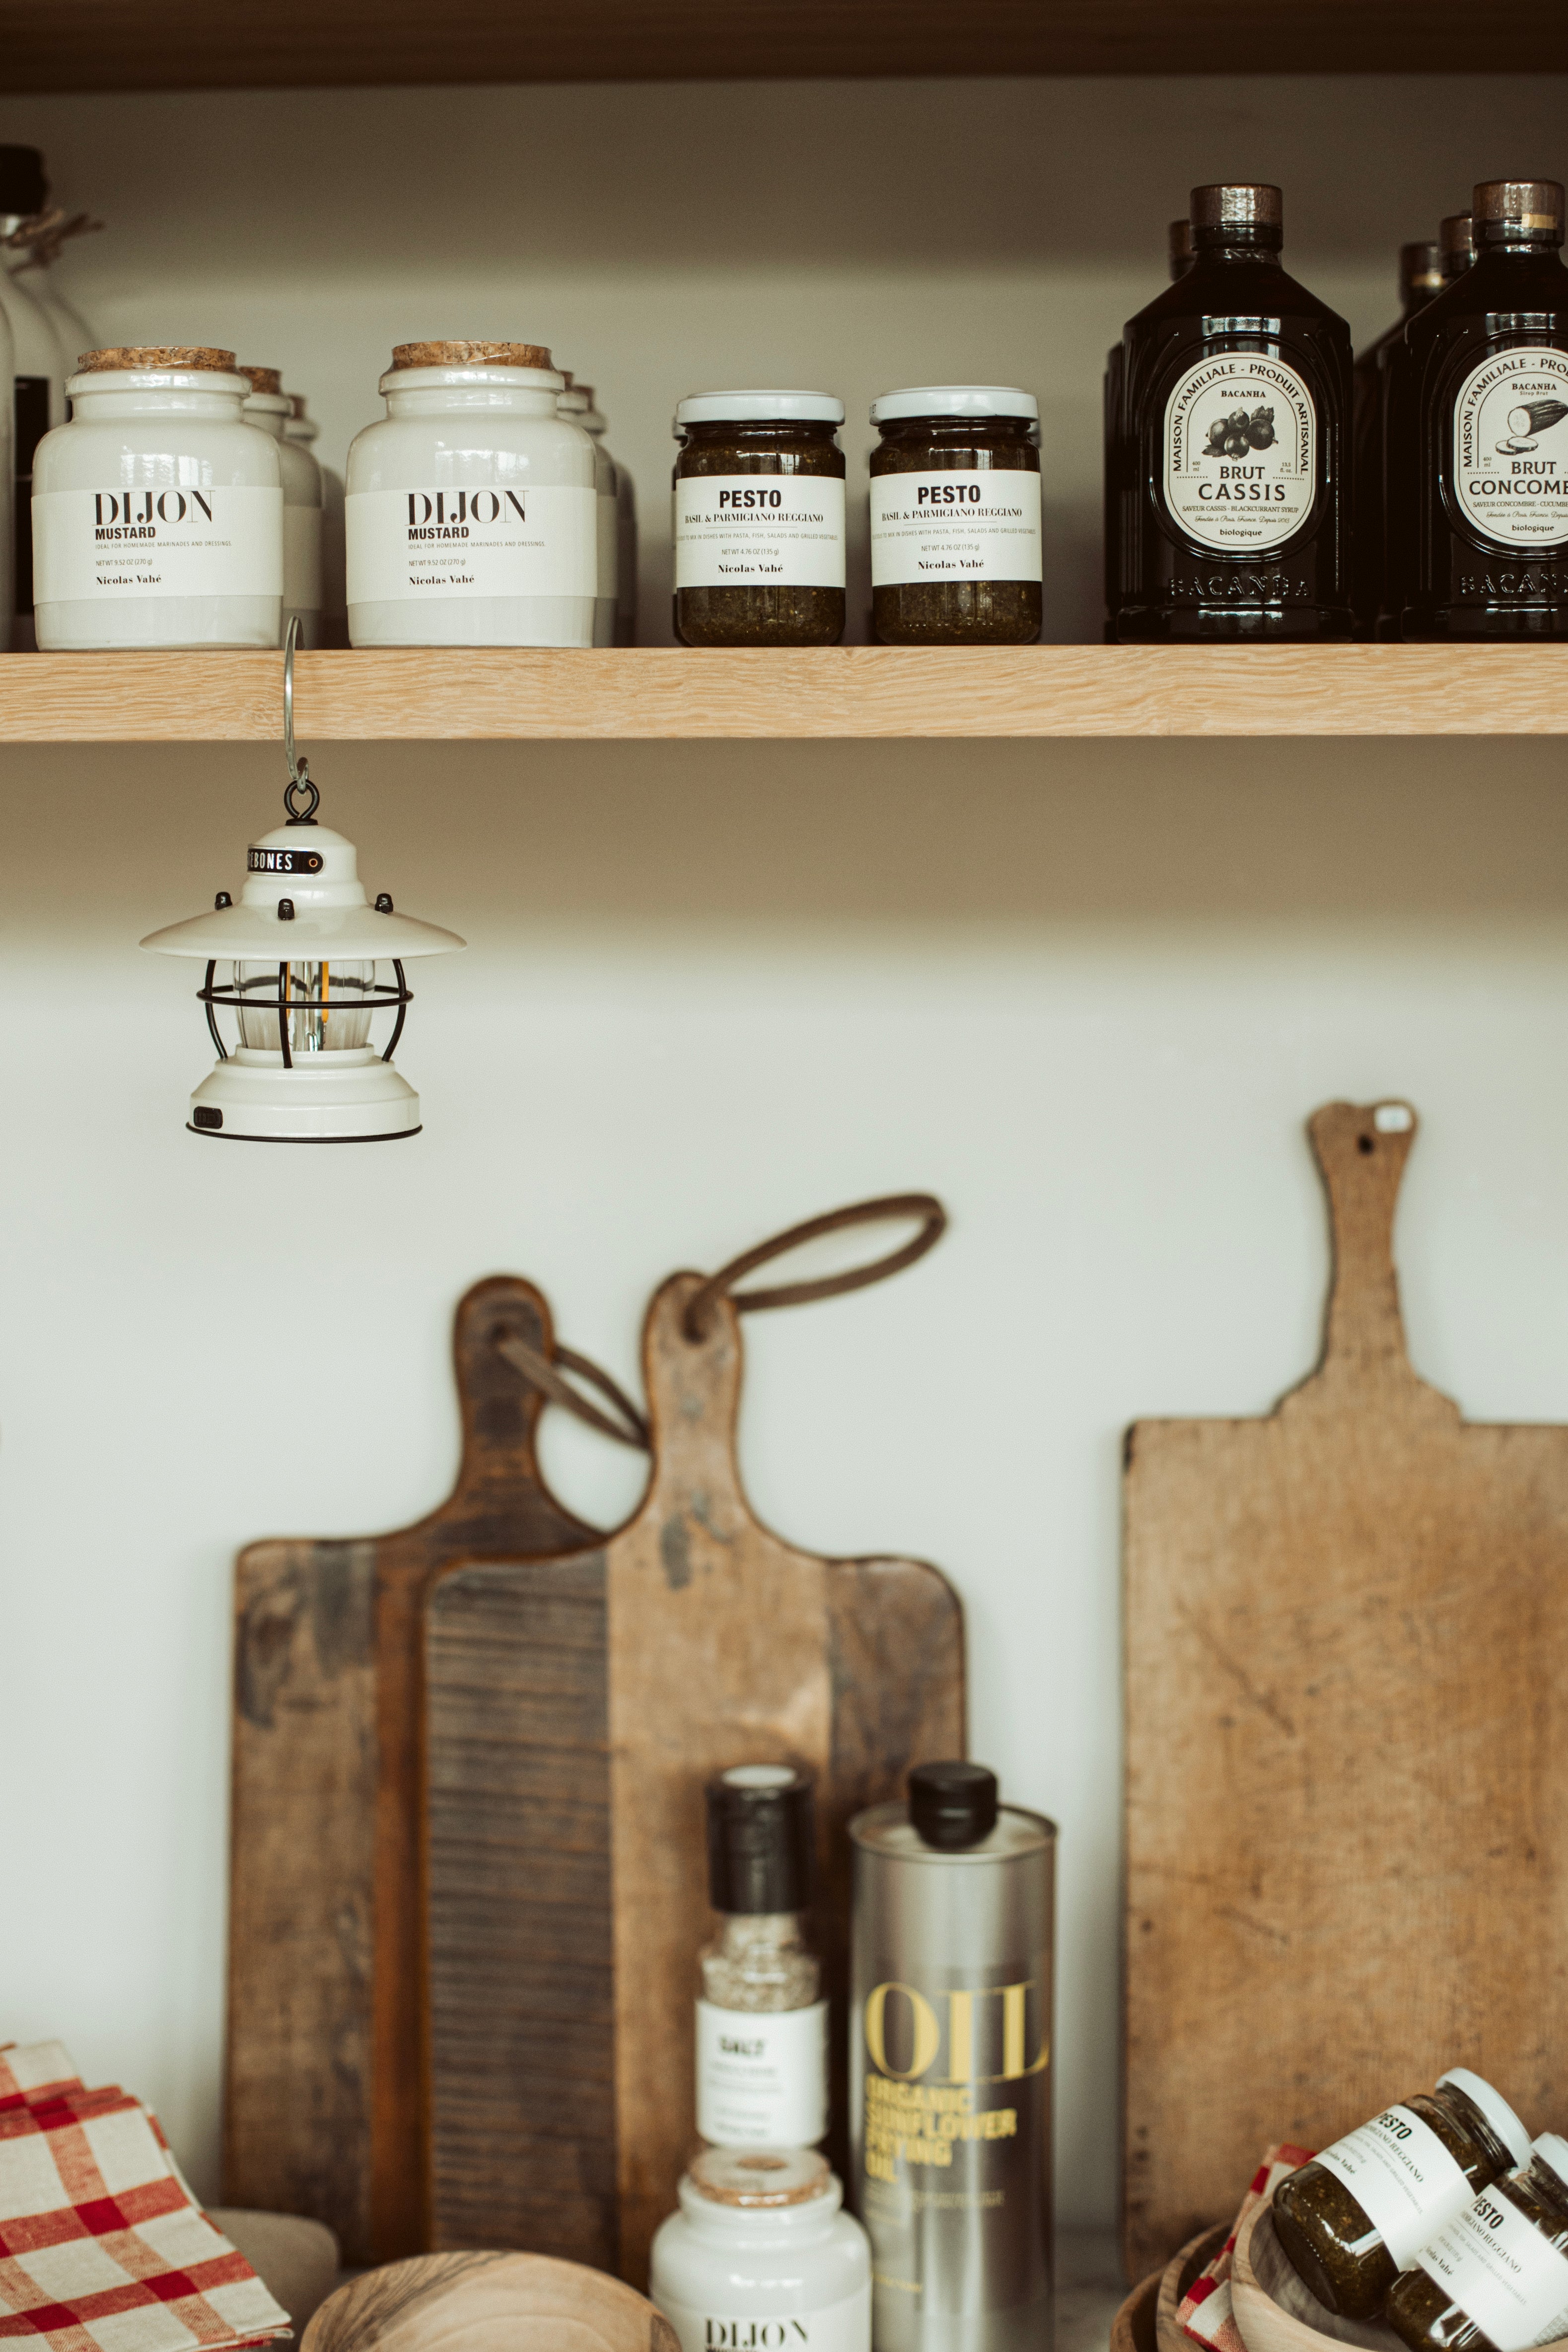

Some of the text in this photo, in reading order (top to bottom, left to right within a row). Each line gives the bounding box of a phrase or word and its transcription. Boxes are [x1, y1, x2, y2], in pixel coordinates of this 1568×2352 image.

[1467, 358, 1526, 407] FAMILIALE
[1173, 415, 1183, 471] MAISON
[1178, 363, 1235, 411] FAMILIALE
[1250, 363, 1300, 399] PRODUIT
[1295, 402, 1309, 475] ARTISANAL
[1463, 411, 1473, 467] MAISON
[1219, 466, 1265, 479] BRUT
[1511, 461, 1557, 474] BRUT
[719, 490, 782, 508] PESTO
[918, 485, 981, 504] PESTO
[1198, 484, 1285, 501] CASSIS
[91, 490, 215, 526] DIJON
[404, 490, 529, 526] DIJON
[882, 512, 901, 521] BASIL
[912, 508, 975, 519] PARMIGIANO
[978, 508, 1022, 517] REGGIANO
[685, 514, 703, 523] BASIL
[714, 513, 775, 522] PARMIGIANO
[779, 513, 823, 523] REGGIANO
[95, 527, 156, 540] MUSTARD
[408, 527, 469, 540] MUSTARD
[1511, 524, 1555, 533] biologique
[718, 564, 783, 572] Nicolas Vahé
[918, 560, 985, 570] Nicolas Vahé
[96, 574, 161, 585] Nicolas Vahé
[409, 574, 475, 585] Nicolas Vahé
[1461, 574, 1568, 594] BACAN
[865, 1980, 1049, 2084] OIL
[1390, 2142, 1424, 2183] REGGIANO
[1470, 2195, 1504, 2229] PESTO
[1483, 2234, 1521, 2273] REGGIANO
[1438, 2259, 1454, 2276] Vahé
[705, 2317, 809, 2348] DIJON
